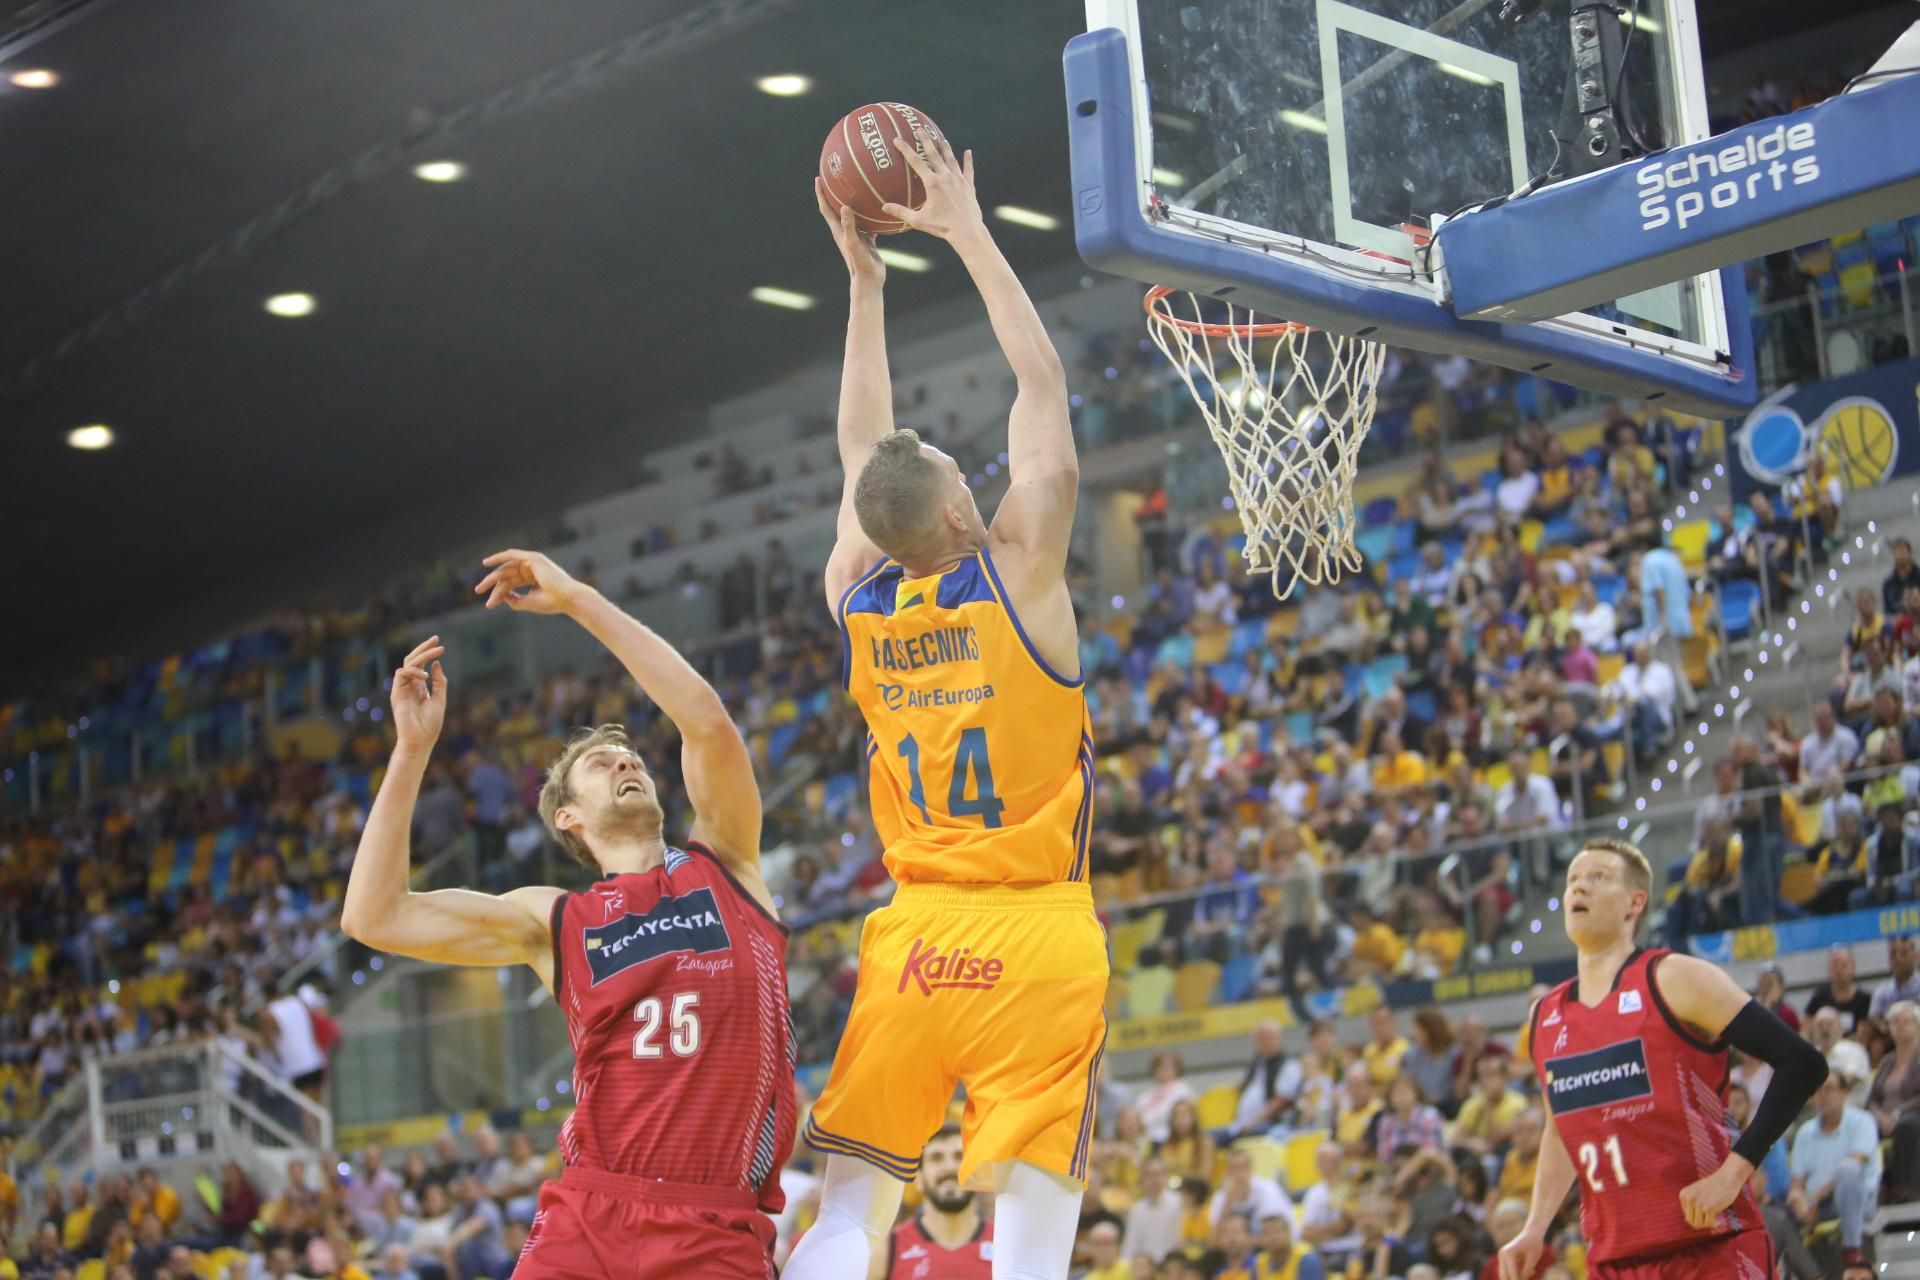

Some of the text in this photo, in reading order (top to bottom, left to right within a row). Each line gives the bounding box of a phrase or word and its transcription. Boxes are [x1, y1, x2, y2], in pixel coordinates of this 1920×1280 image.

[859, 112, 890, 169] TF-1000
[1636, 122, 1816, 198] Schelde
[1639, 154, 1821, 231] Sports
[897, 726, 1005, 830] 14
[897, 938, 1004, 997] Kalise
[632, 991, 701, 1060] 25
[1578, 1133, 1630, 1193] 21
